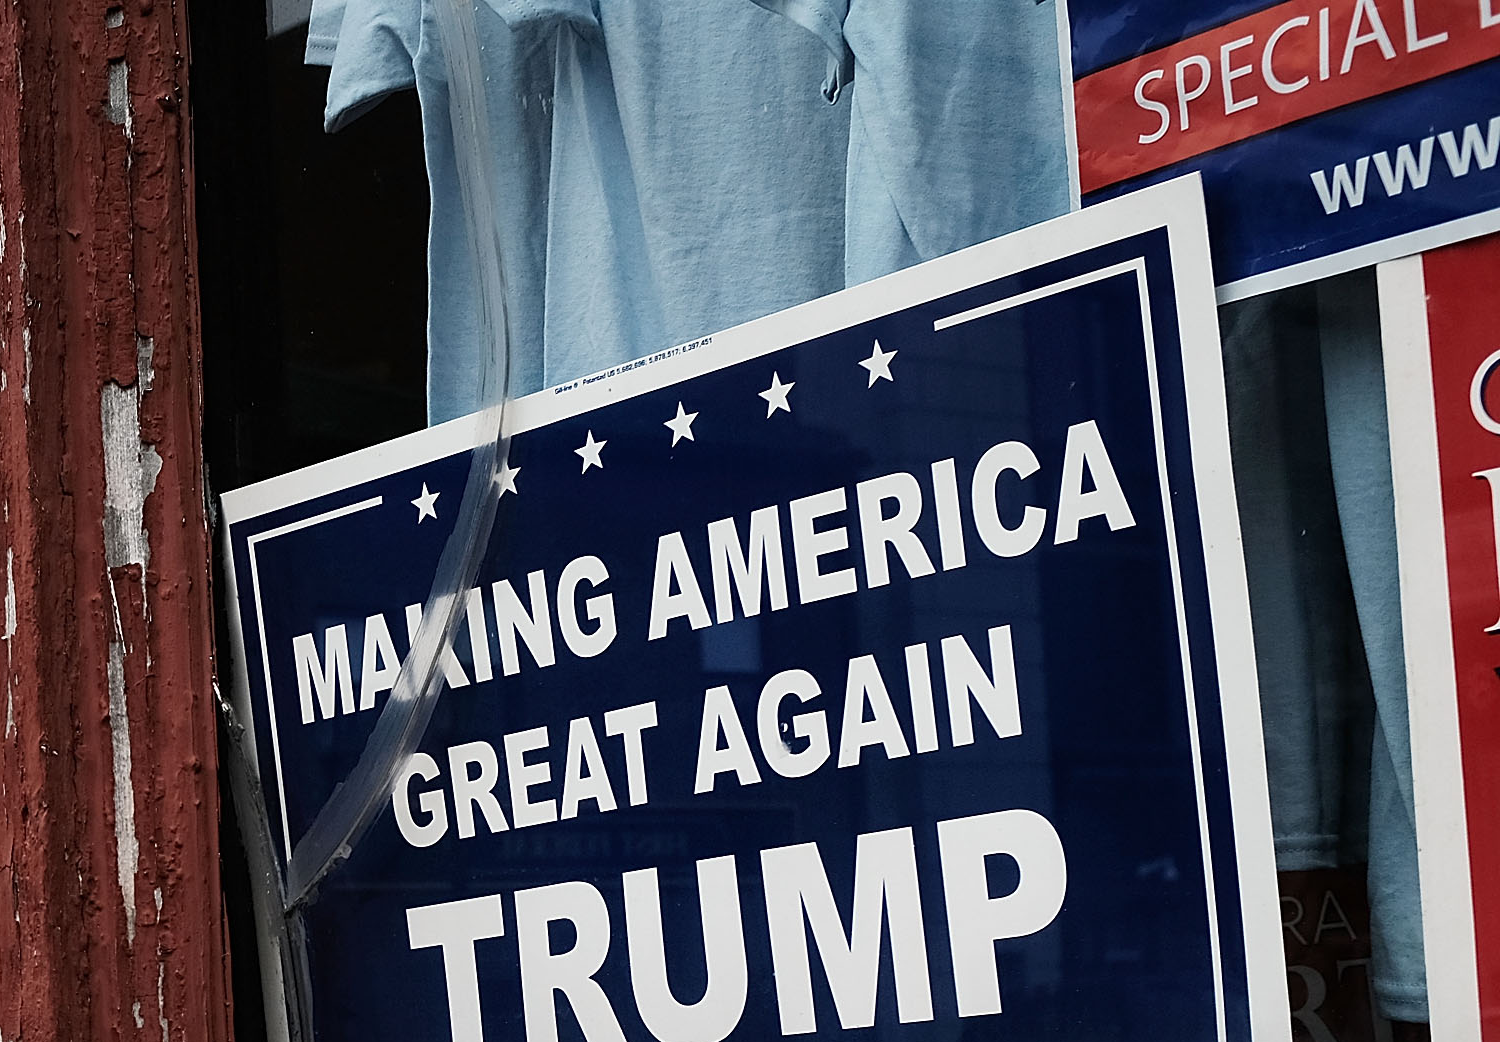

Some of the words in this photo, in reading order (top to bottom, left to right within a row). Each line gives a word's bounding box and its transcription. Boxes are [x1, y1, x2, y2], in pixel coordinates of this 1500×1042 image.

[1133, 0, 1450, 146] SPECIAL
[607, 369, 616, 378] US
[292, 555, 618, 726] MAKING
[647, 419, 1137, 641] AMERICA
[390, 700, 659, 848] GREAT
[693, 624, 1023, 795] AGAIN
